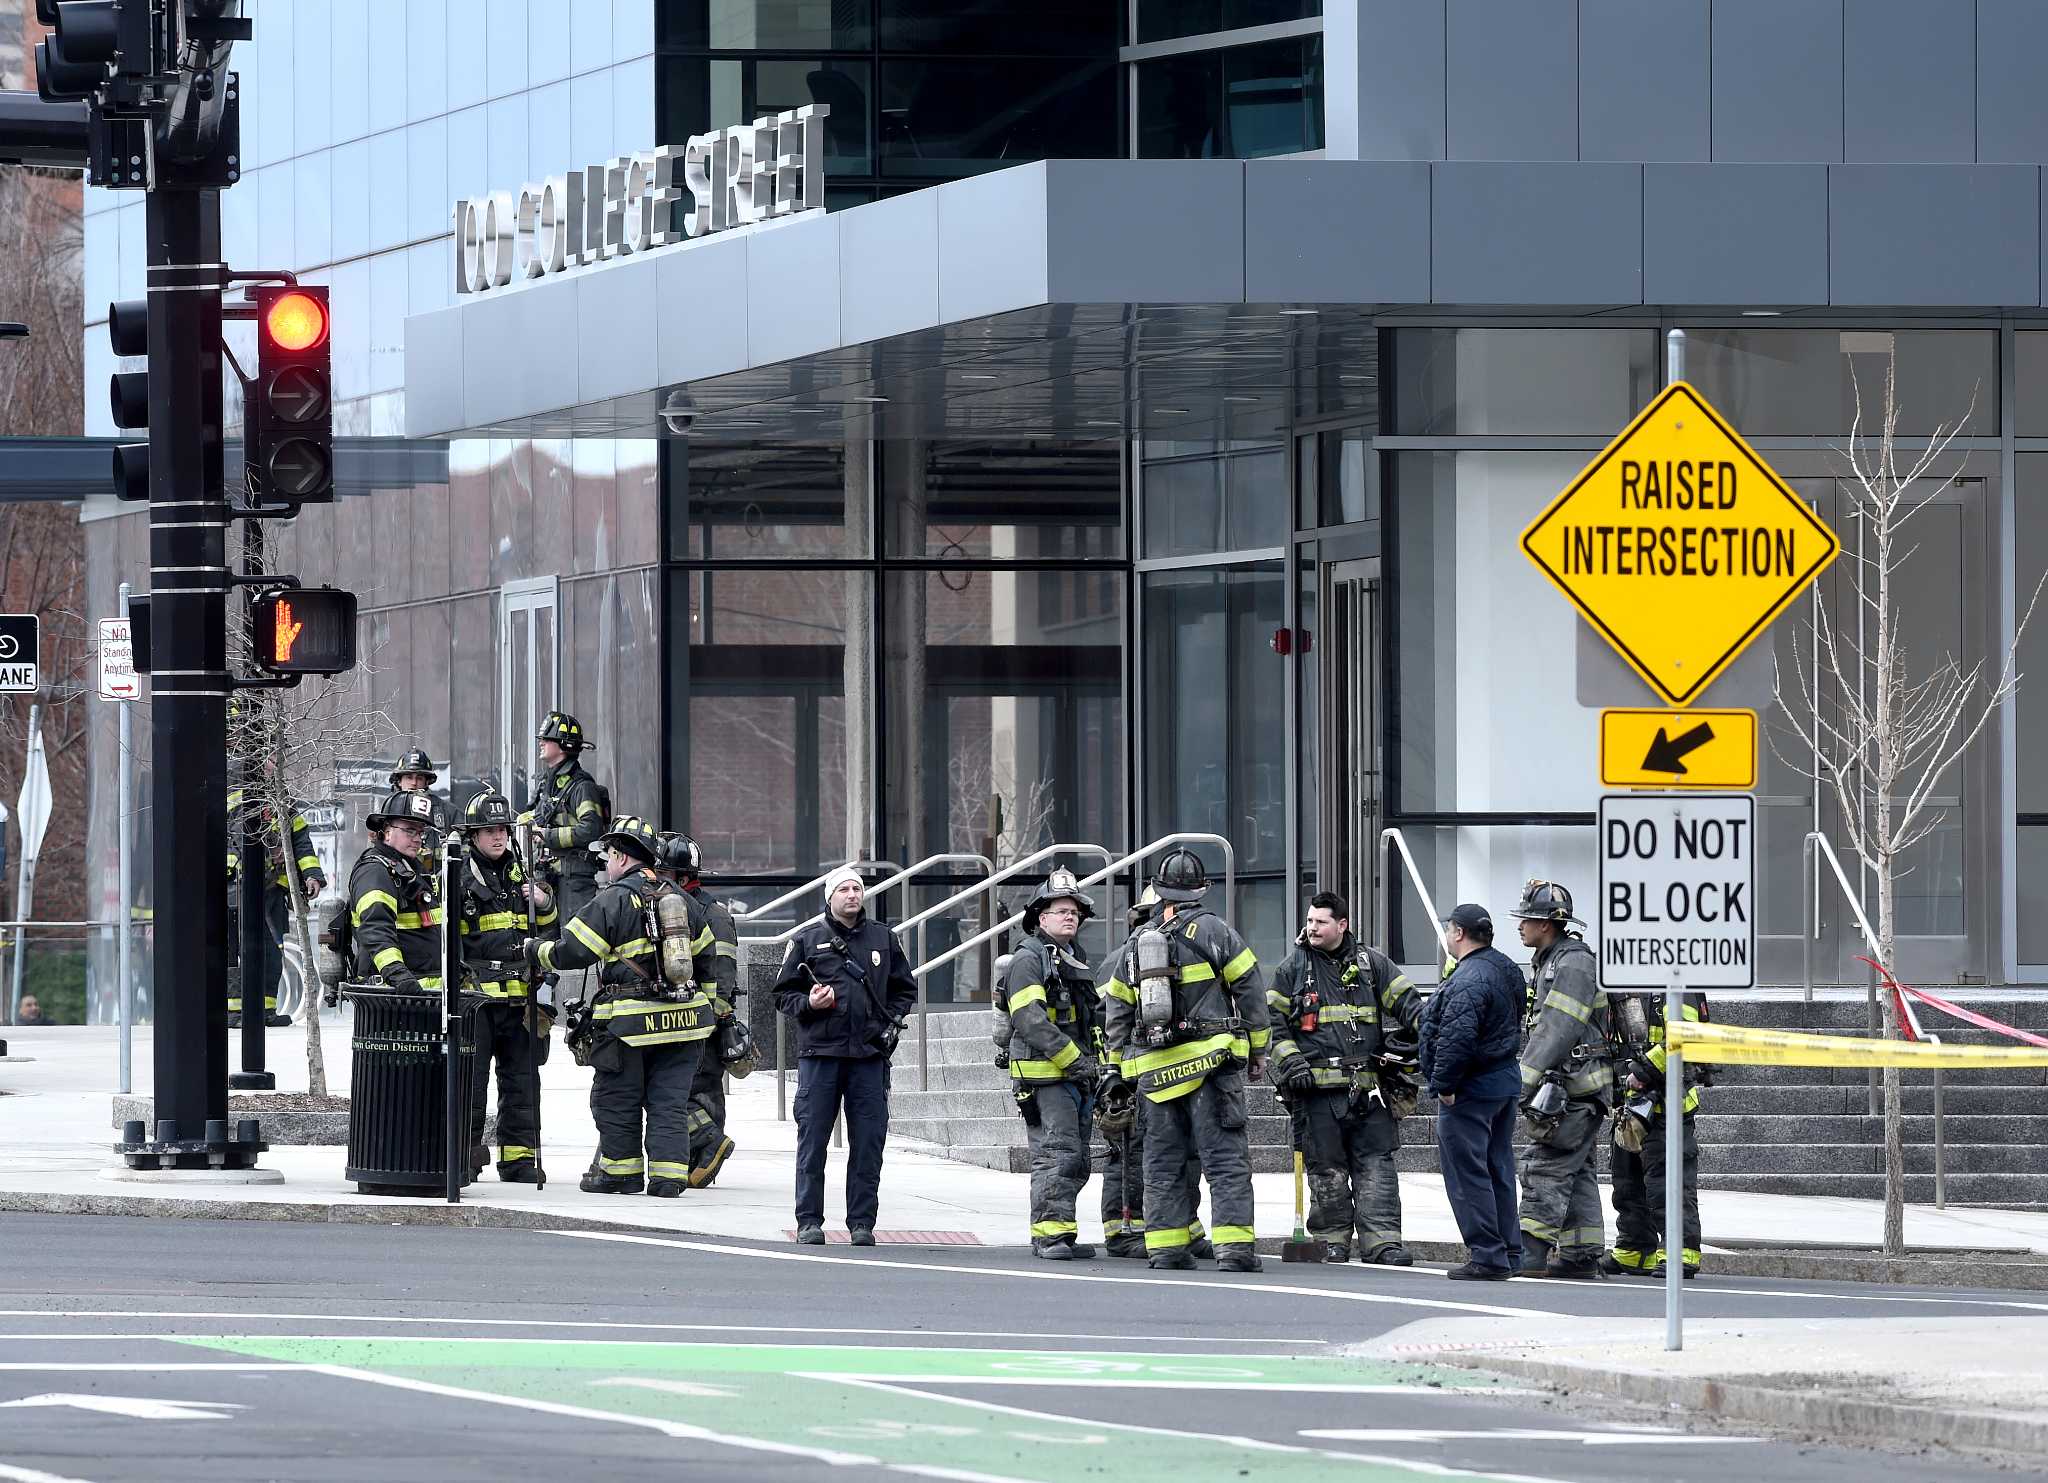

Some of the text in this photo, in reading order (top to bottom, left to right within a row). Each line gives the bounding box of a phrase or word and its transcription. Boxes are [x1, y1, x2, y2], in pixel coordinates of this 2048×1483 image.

[517, 144, 685, 280] COLLEGE
[684, 103, 831, 237] STREET
[1620, 460, 1738, 510] RAISED
[1562, 526, 1796, 577] INTERSECTION
[112, 627, 127, 643] NO
[103, 647, 132, 658] Standin
[0, 668, 33, 685] ANE
[410, 753, 420, 764] 2
[418, 798, 429, 812] 3
[489, 802, 503, 814] 10
[1607, 819, 1747, 859] DO NOT
[1061, 875, 1071, 887] 1
[1608, 881, 1747, 923] BLOCK
[1606, 937, 1747, 967] INTERSECTION
[365, 1040, 389, 1051] Green
[392, 1042, 429, 1052] District
